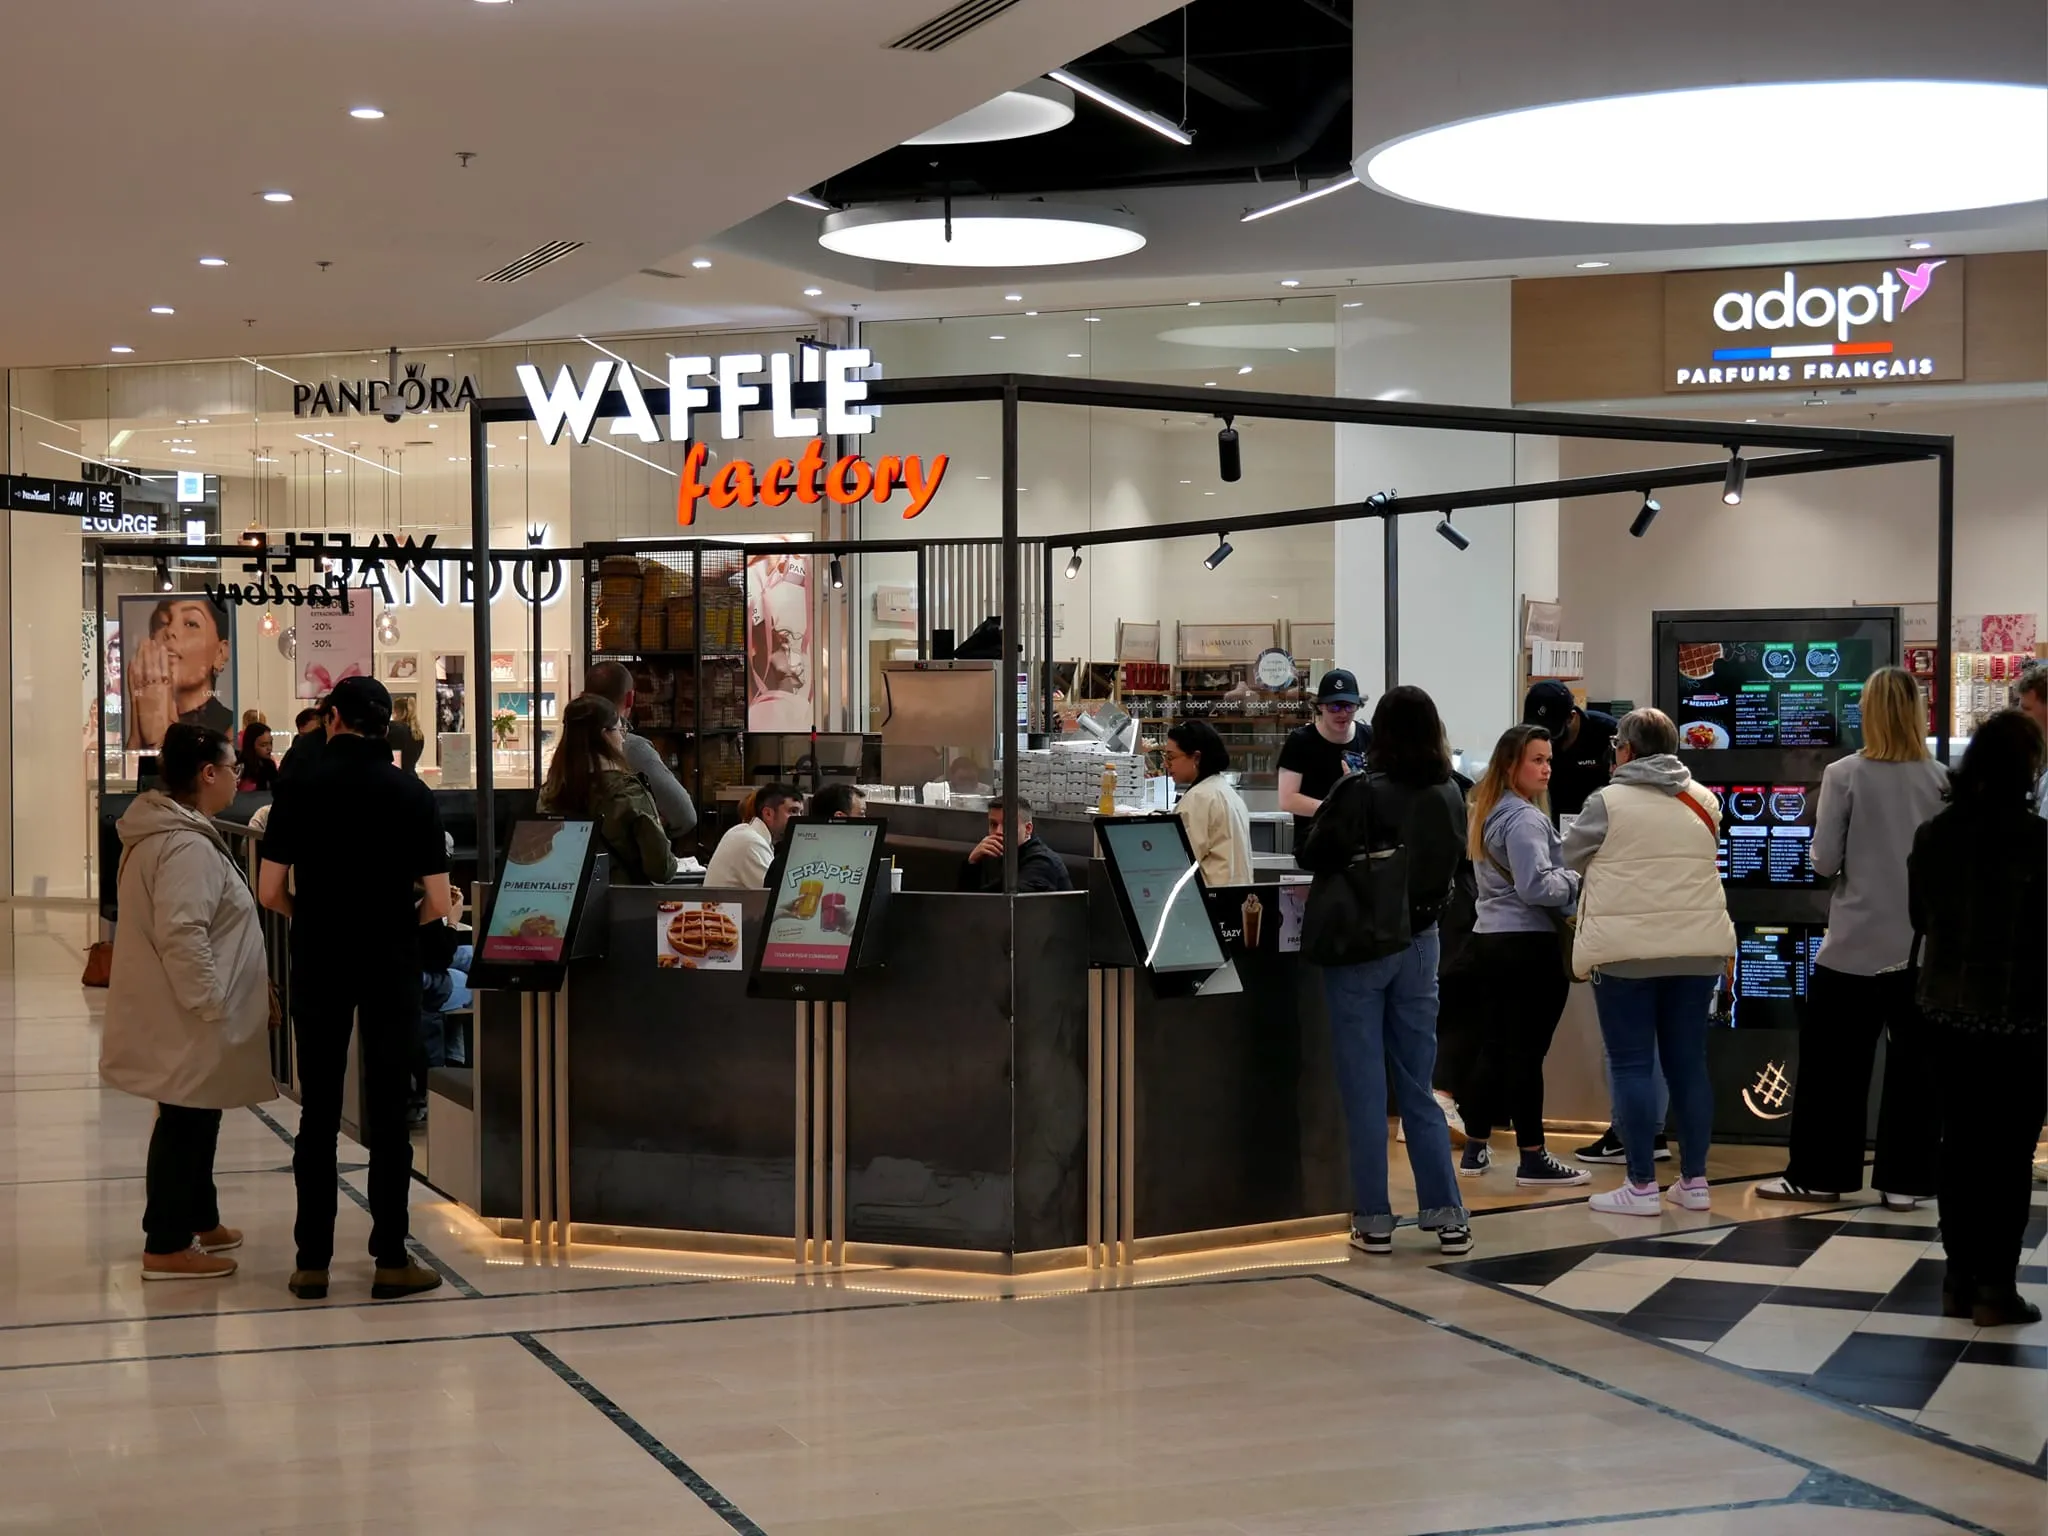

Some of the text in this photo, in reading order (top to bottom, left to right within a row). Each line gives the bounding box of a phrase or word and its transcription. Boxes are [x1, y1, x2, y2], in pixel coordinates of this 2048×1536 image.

[1712, 271, 1901, 342] adopt
[1676, 357, 1934, 385] PARFUMS FRANÇAIS
[293, 375, 478, 417] PANDORA
[516, 348, 873, 446] WAFFLE
[677, 438, 950, 526] factory
[99, 491, 114, 505] PC
[311, 622, 332, 631] -20%
[311, 639, 332, 648] -30%
[1127, 700, 1149, 711] adopt
[1156, 700, 1178, 711] adopt
[1186, 700, 1208, 711] adopt
[1216, 700, 1239, 711] adopt
[1247, 700, 1269, 711] adopt
[1277, 700, 1300, 711] adopt
[787, 860, 864, 889] FRAPPÉ
[1221, 929, 1241, 937] RAZY
